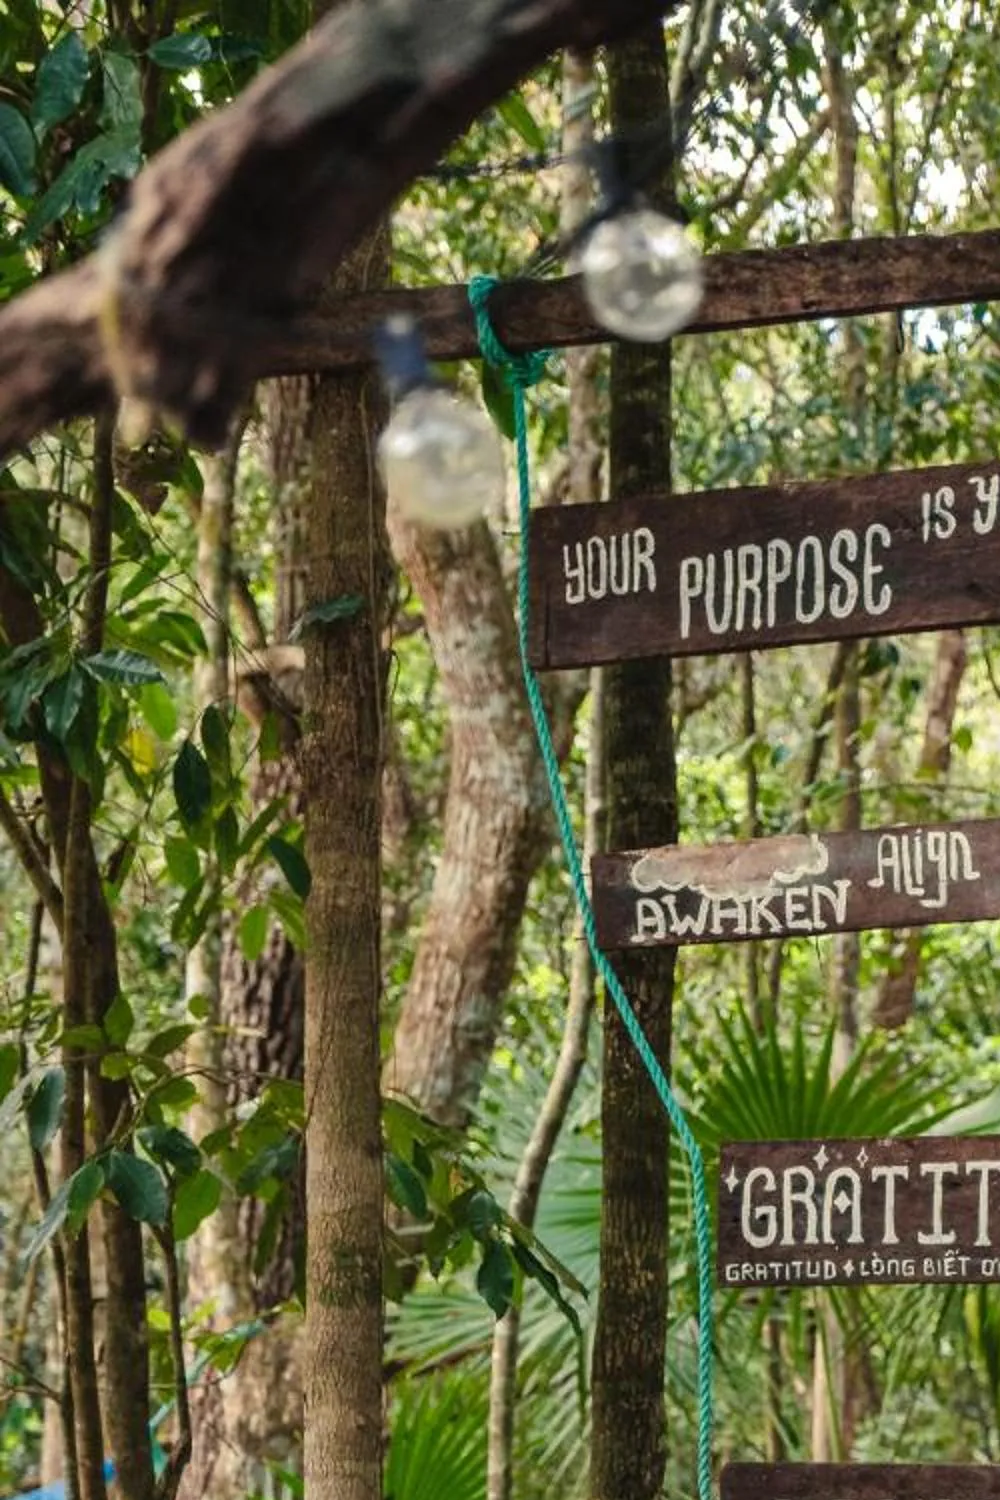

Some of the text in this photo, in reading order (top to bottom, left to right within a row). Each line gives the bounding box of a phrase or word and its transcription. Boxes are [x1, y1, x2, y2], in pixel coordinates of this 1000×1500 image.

[562, 527, 658, 604] YOUR
[679, 523, 893, 639] PURPOSE
[921, 485, 957, 542] IS
[630, 879, 850, 943] AWAKEN
[725, 1261, 838, 1282] GRATITUD
